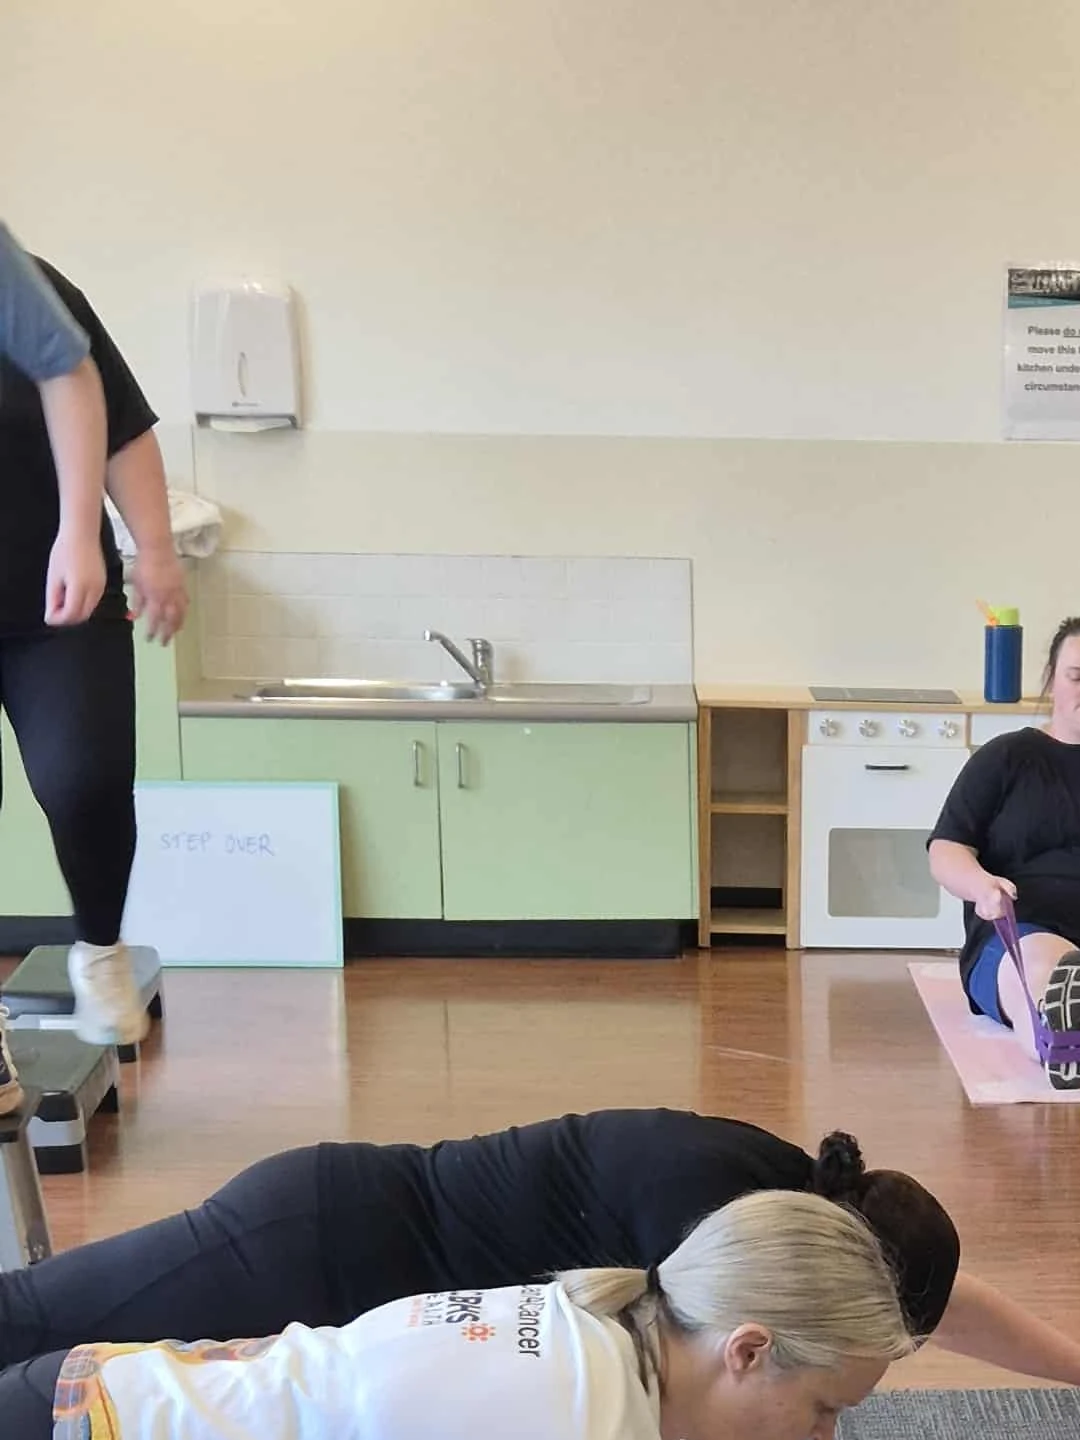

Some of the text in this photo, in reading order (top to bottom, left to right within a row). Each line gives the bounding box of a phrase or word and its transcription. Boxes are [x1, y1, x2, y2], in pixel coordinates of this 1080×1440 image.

[1027, 326, 1061, 336] Please
[1063, 326, 1076, 337] do
[1027, 346, 1055, 354] move
[1057, 345, 1076, 354] this
[1017, 363, 1054, 373] kitchen
[160, 831, 275, 857] STEP OVER
